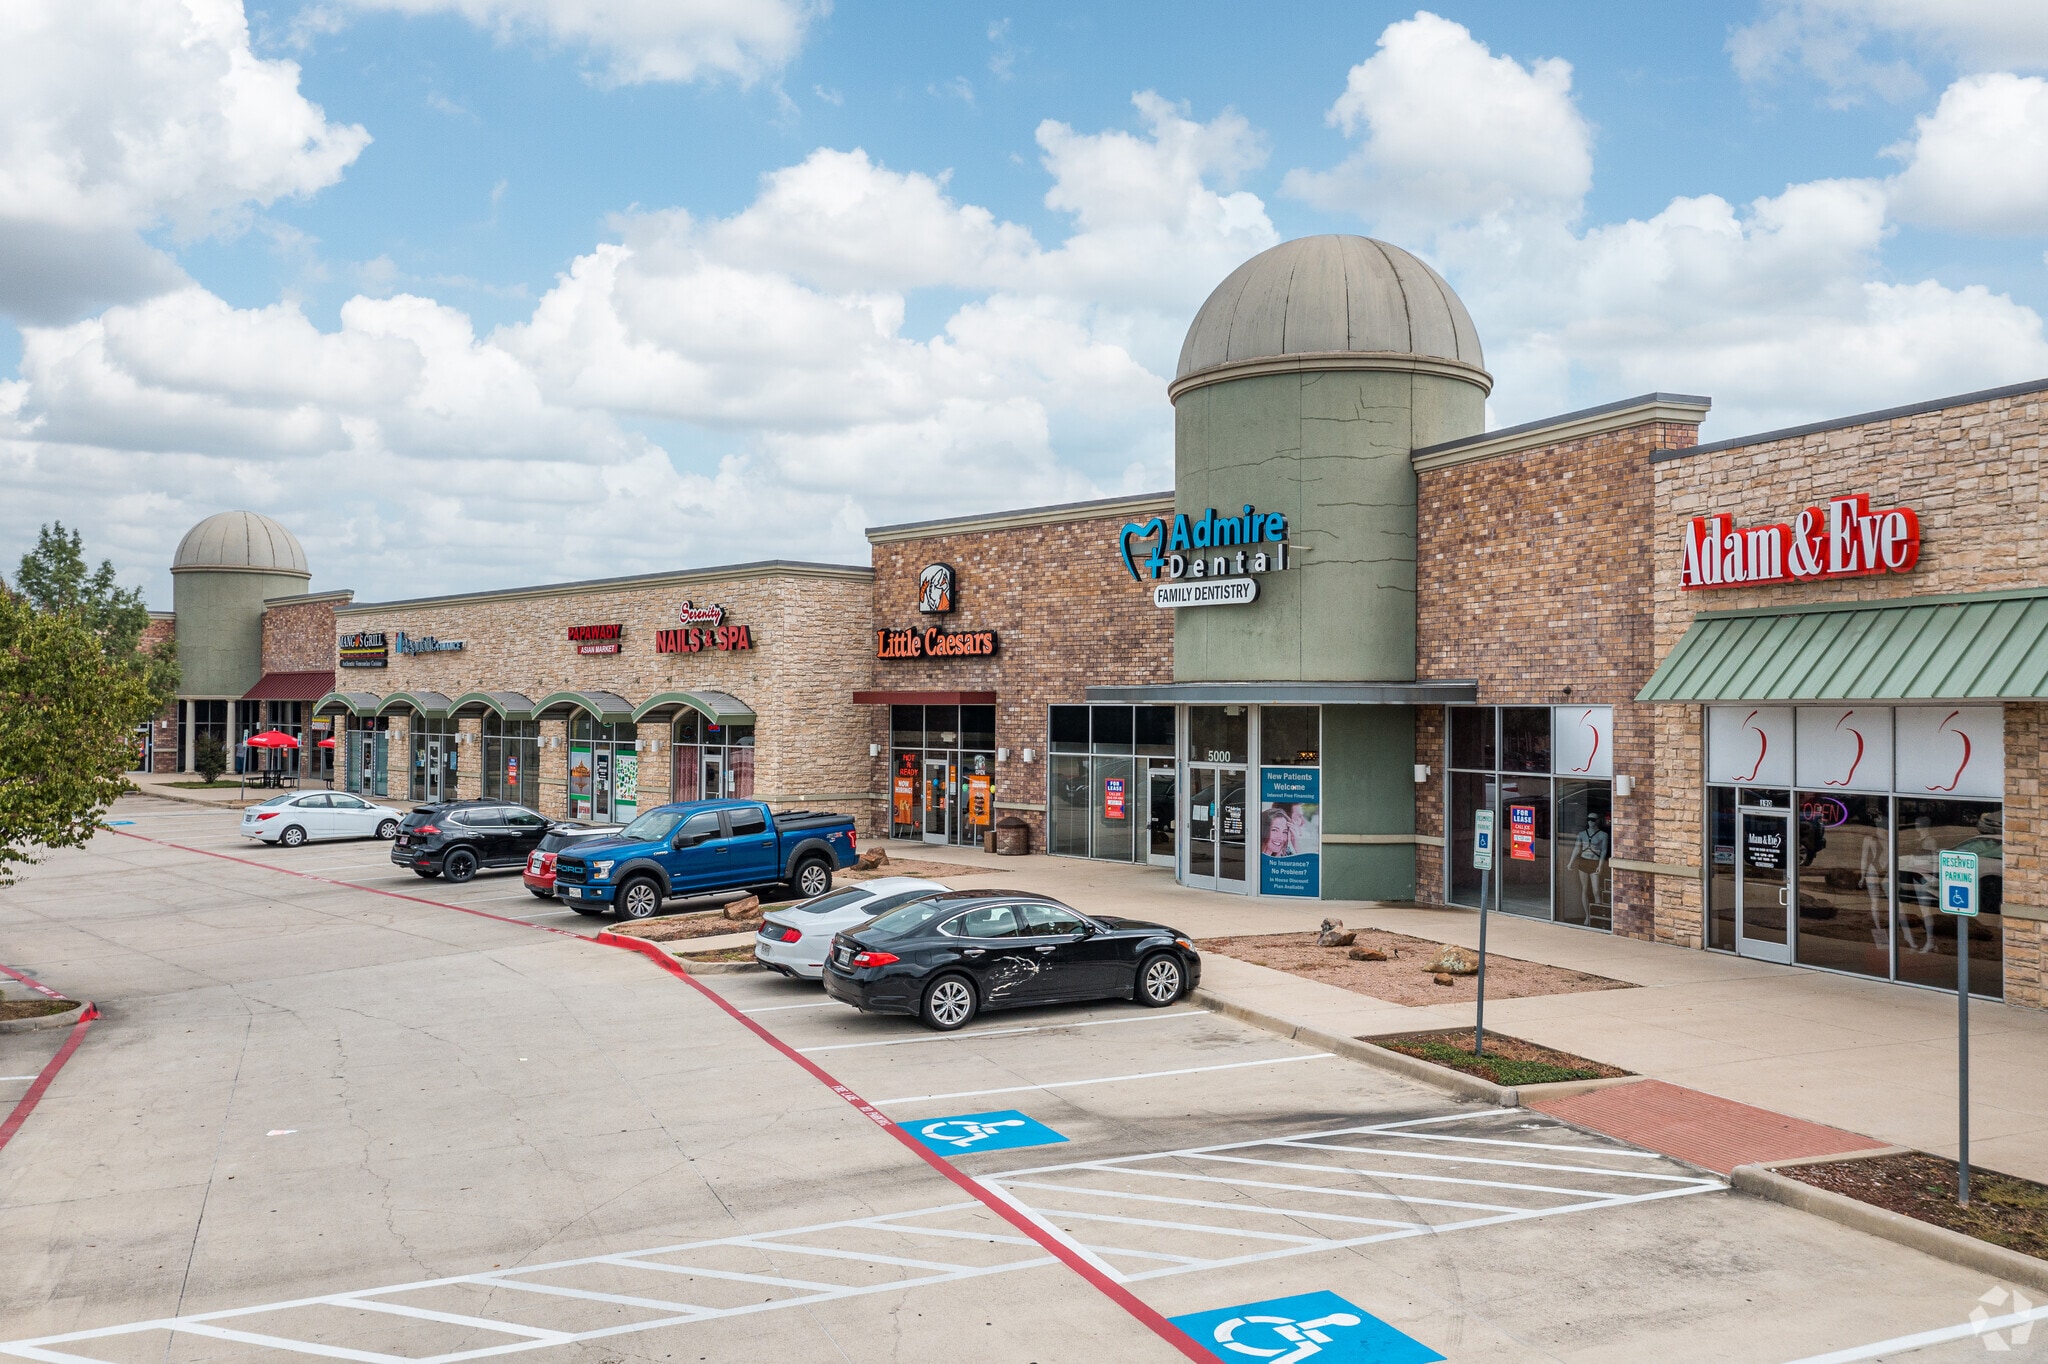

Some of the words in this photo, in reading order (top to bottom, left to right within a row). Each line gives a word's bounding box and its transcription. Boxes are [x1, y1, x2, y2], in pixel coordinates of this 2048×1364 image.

[1170, 504, 1284, 550] Admire
[1678, 517, 1783, 588] Adam
[1787, 510, 1824, 577] &
[1826, 498, 1908, 573] Eve
[1169, 543, 1284, 579] Dental
[1157, 587, 1193, 603] FAMILY
[1194, 583, 1250, 601] DENTISTRY
[679, 600, 723, 627] Serenity
[364, 633, 383, 647] GRILL
[656, 627, 702, 654] NAILS
[705, 629, 714, 648] &
[717, 625, 751, 651] SPA
[877, 628, 921, 658] Little
[924, 627, 993, 657] Caesars
[580, 646, 594, 654] ASIAN
[595, 644, 616, 653] MARKET
[1208, 750, 1231, 763] 5000
[900, 768, 919, 776] READY
[1267, 772, 1282, 780] New
[1283, 772, 1313, 781] Patients
[1273, 782, 1306, 791] Welcome
[1803, 802, 1840, 822] OPEN
[1513, 815, 1532, 824] LEASE
[1748, 833, 1763, 844] Adam
[556, 863, 584, 874] FORD
[1942, 856, 1975, 869] RESERVED
[1944, 870, 1973, 884] PARKING
